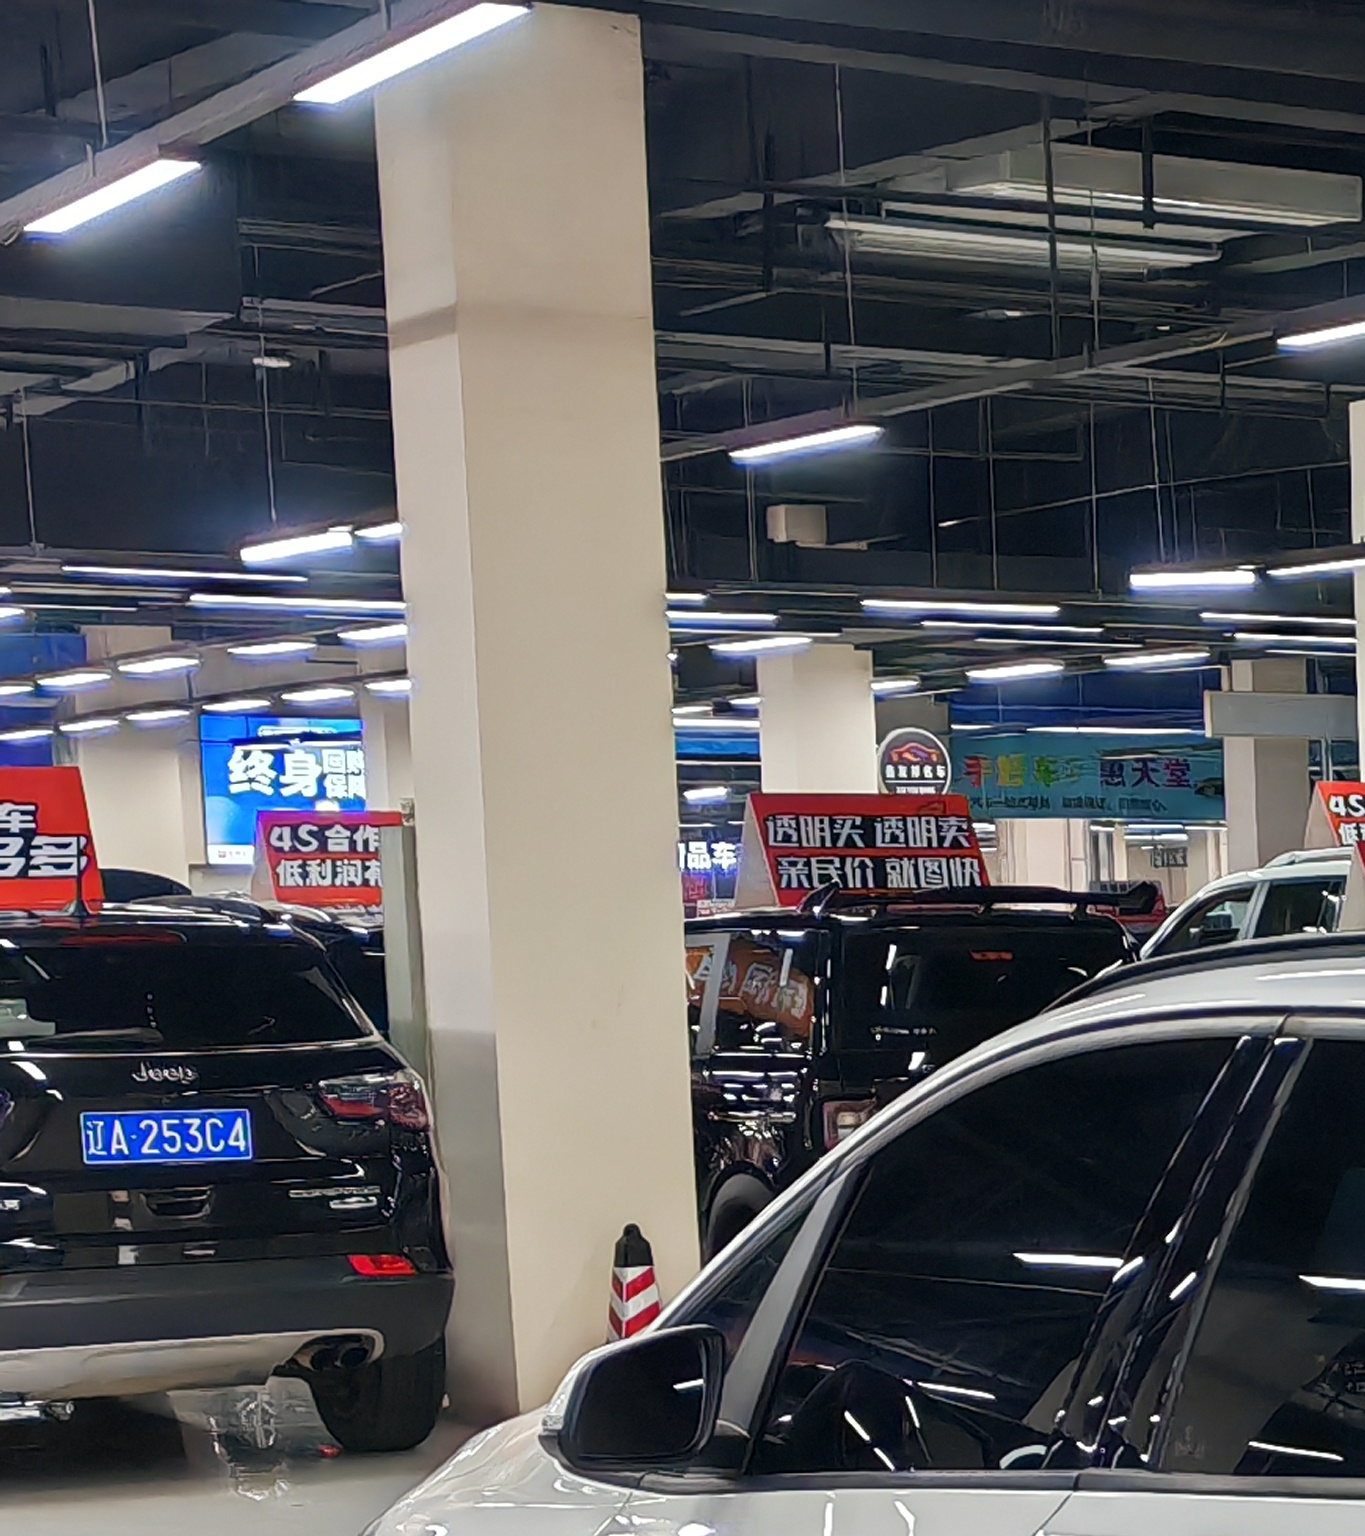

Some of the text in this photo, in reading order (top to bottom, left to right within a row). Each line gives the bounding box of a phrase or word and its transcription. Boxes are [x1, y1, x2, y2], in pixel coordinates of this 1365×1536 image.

[228, 749, 322, 797] 终身
[767, 815, 968, 848] 透明买 透明卖
[777, 857, 981, 889] 亲民价 就图快
